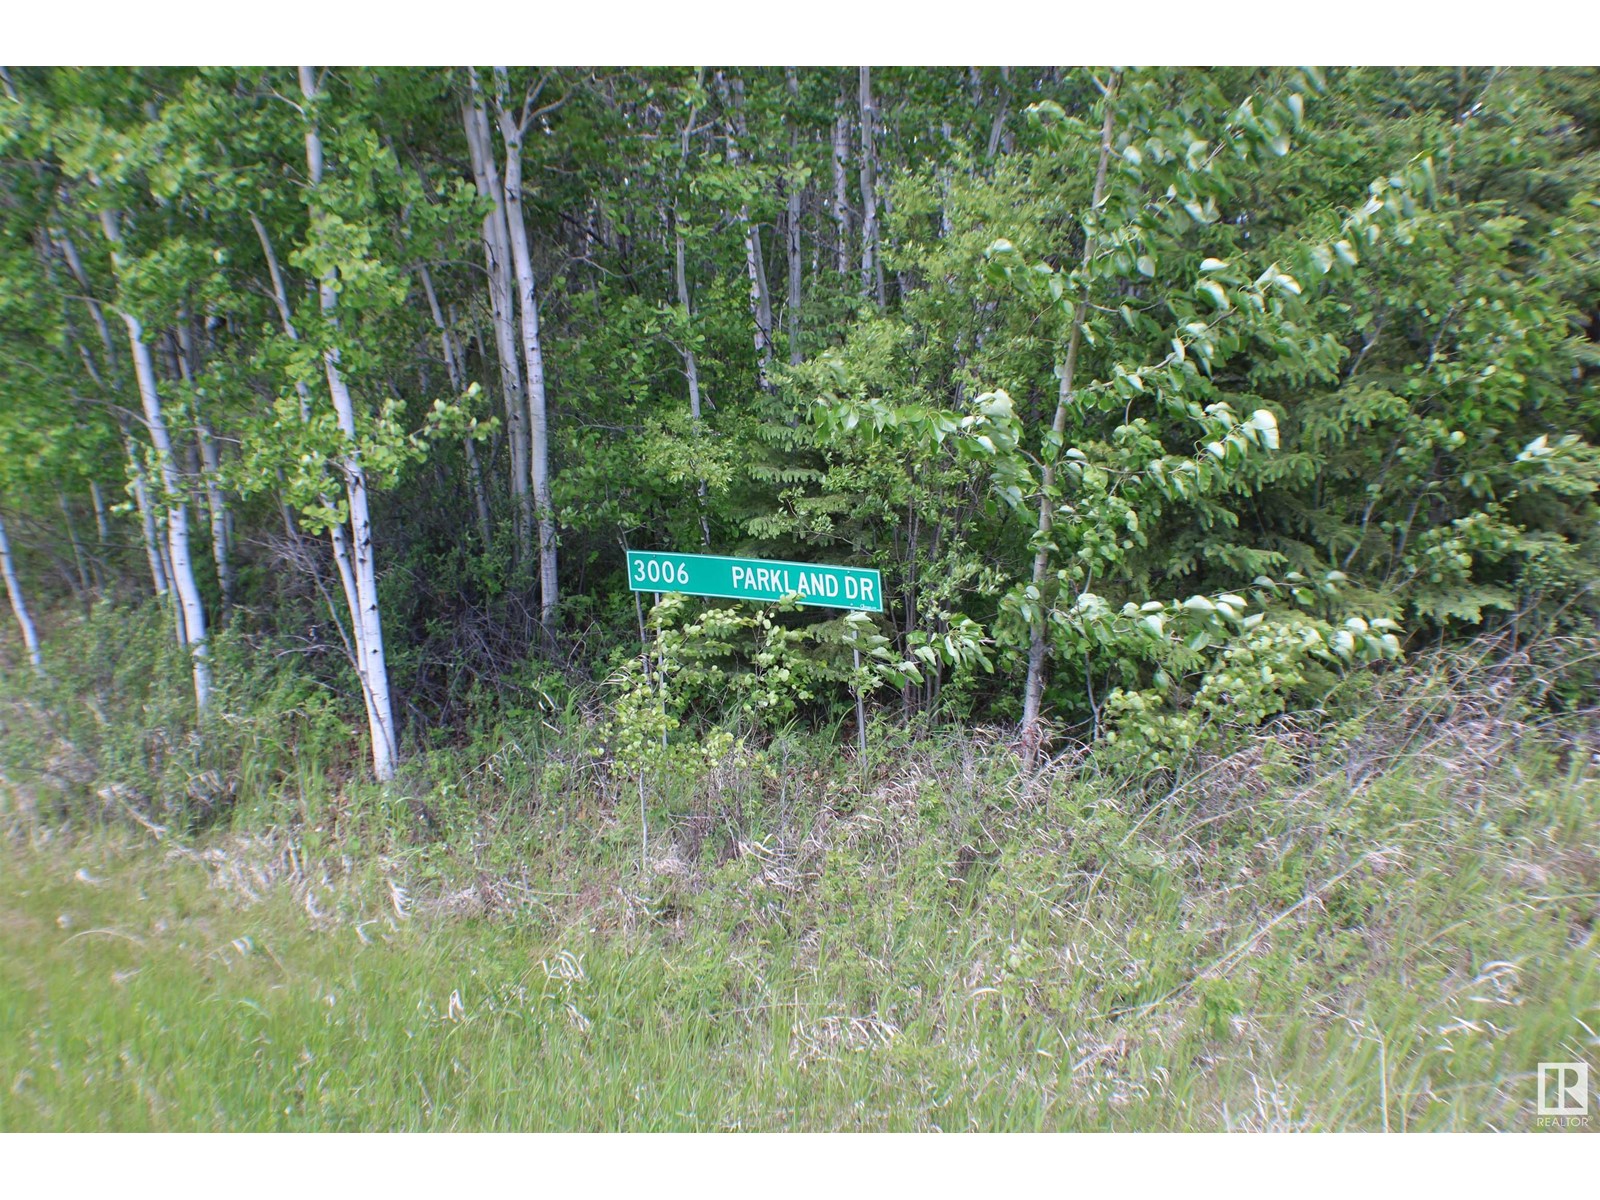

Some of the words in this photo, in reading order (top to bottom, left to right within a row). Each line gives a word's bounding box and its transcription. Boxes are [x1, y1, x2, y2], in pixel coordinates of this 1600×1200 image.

[633, 559, 690, 585] 3006
[731, 566, 839, 597] PARKLAND
[844, 575, 875, 601] DR
